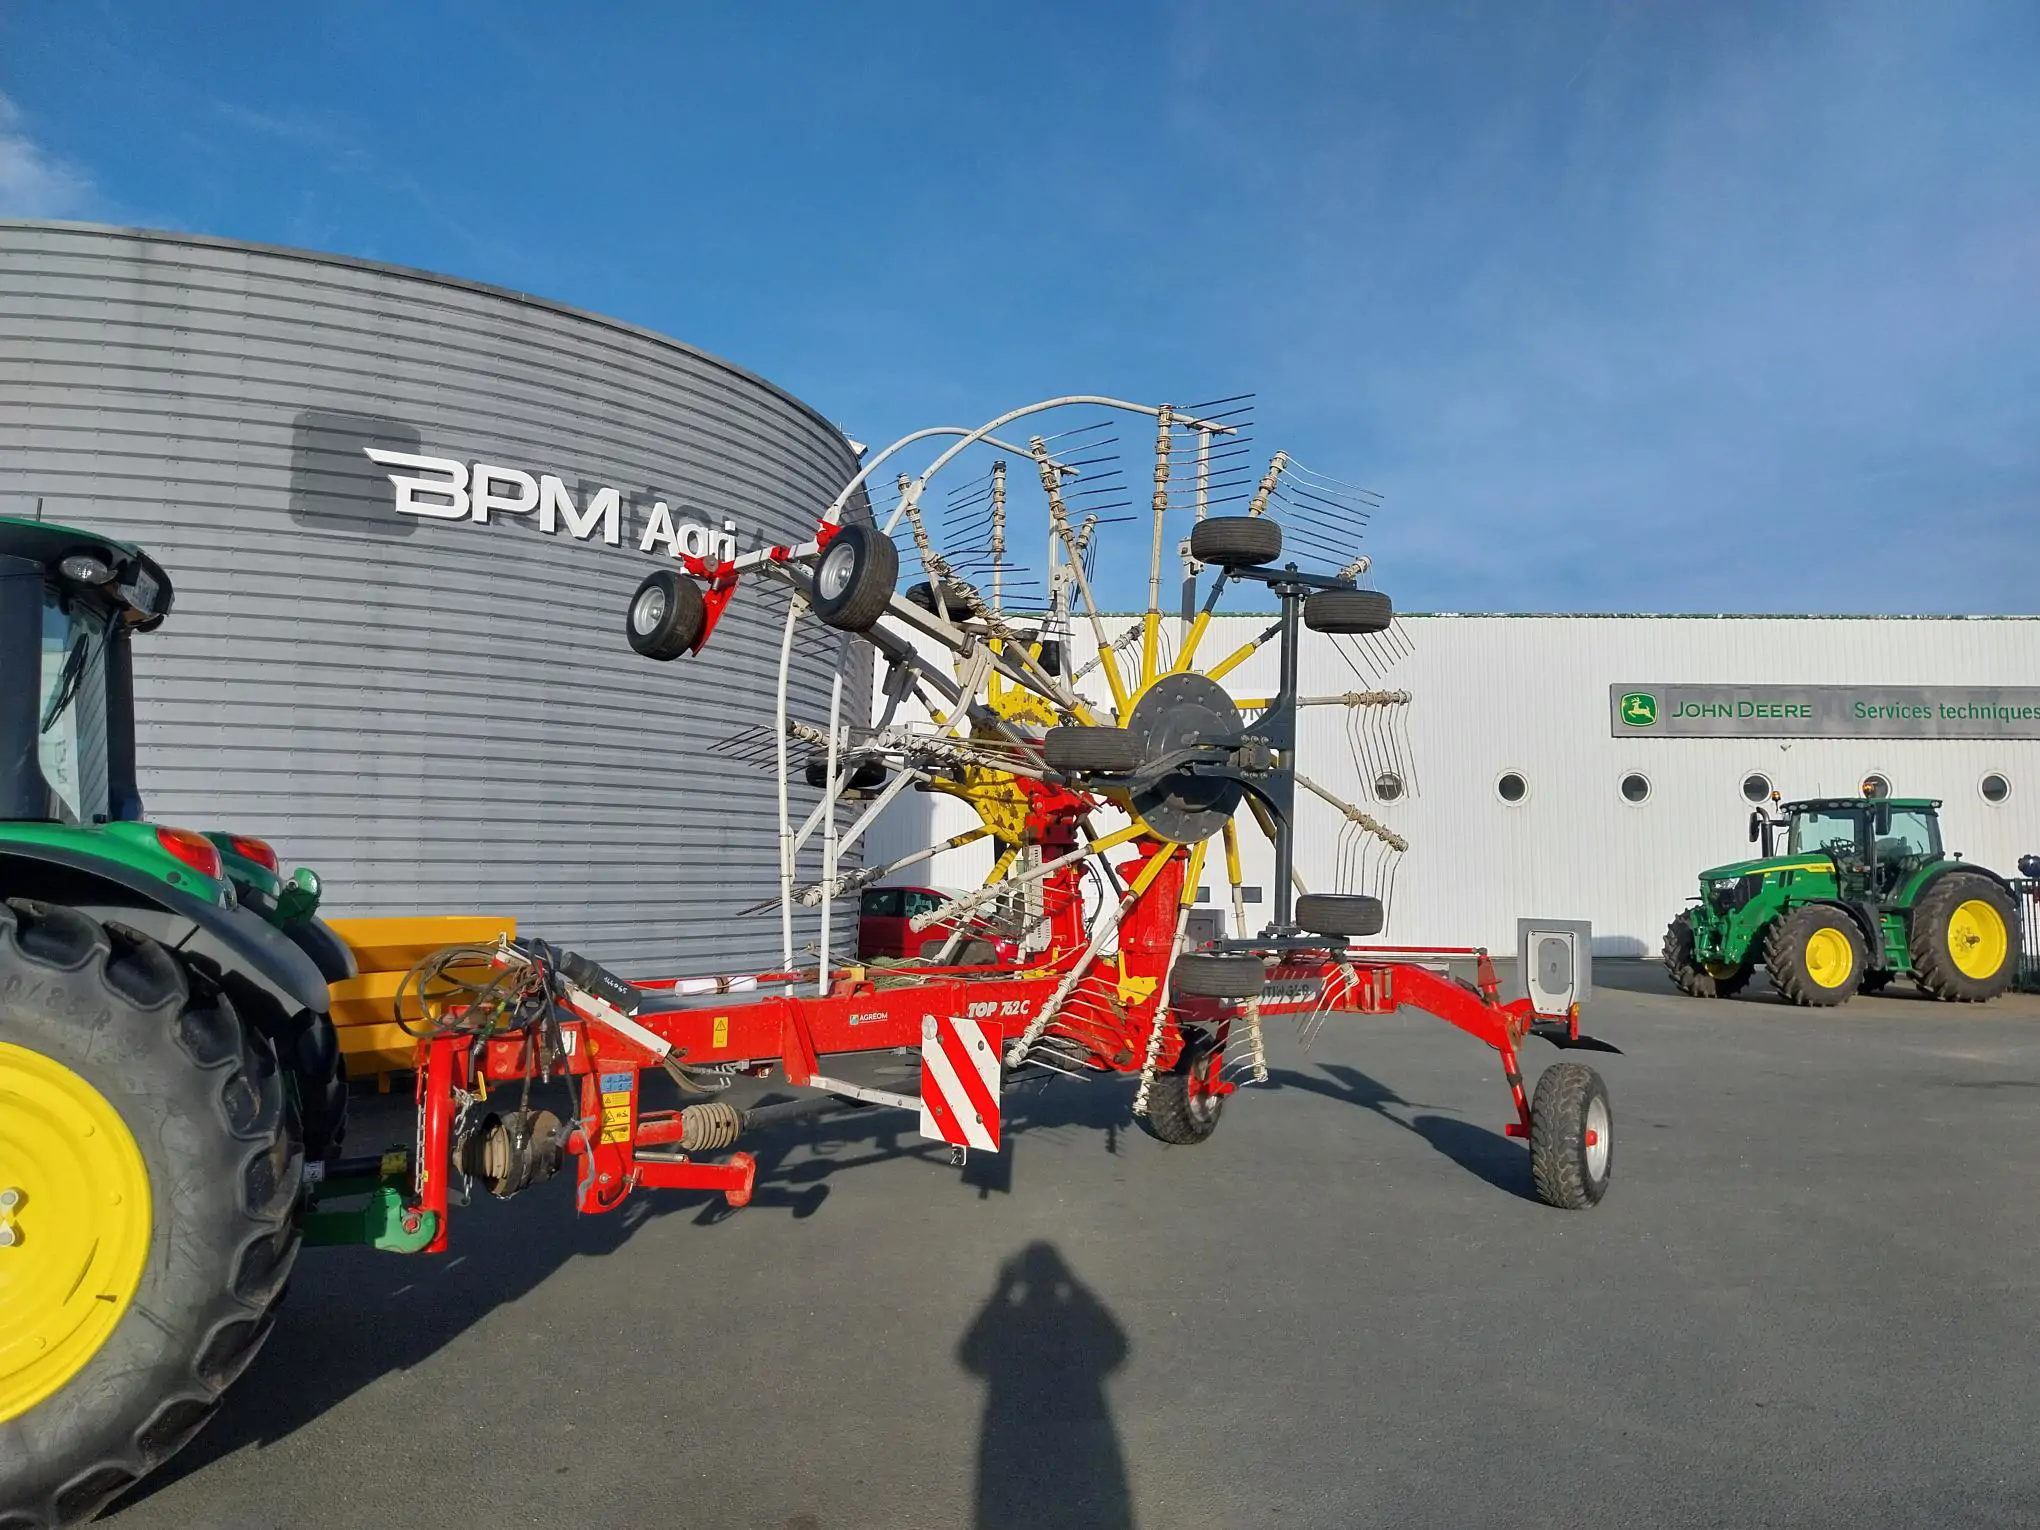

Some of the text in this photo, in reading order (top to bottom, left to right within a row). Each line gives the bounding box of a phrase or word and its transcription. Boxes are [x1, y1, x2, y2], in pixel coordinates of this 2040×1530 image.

[363, 447, 620, 544] BPM
[1672, 701, 1813, 718] JOHN DEERE
[1854, 701, 2040, 723] Services techniques
[968, 1001, 998, 1018] TOP
